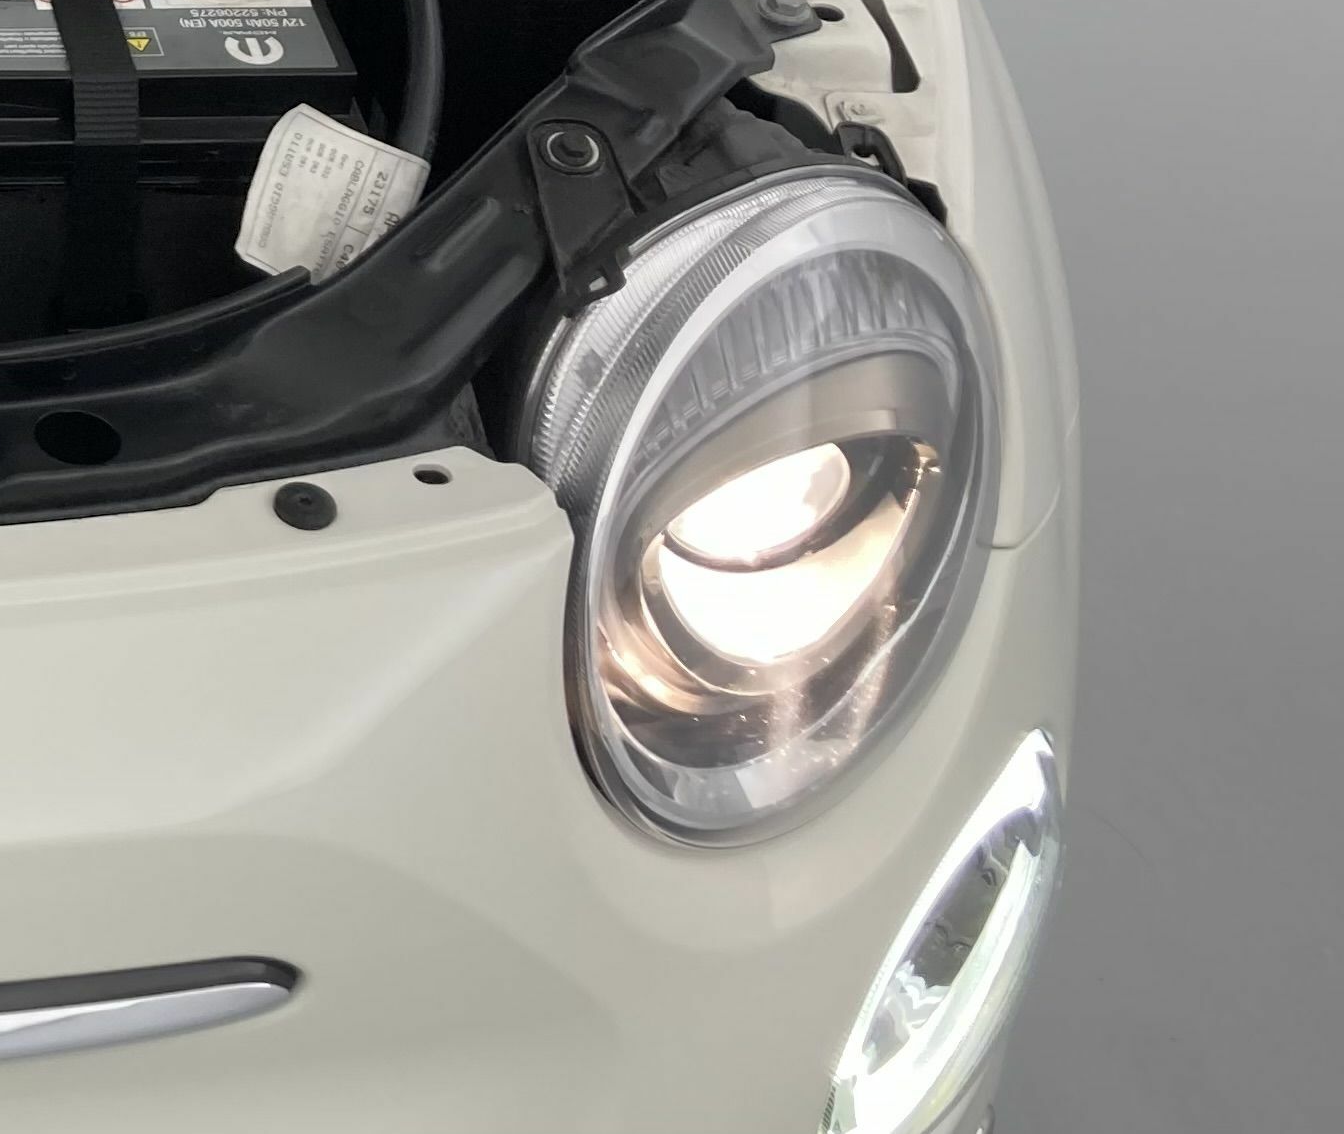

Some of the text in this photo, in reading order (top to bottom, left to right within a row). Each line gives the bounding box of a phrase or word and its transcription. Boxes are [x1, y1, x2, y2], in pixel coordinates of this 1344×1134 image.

[259, 8, 288, 17] PN:
[179, 17, 307, 28] 12V 50Ah 500A (EN)
[363, 171, 389, 216] 23175
